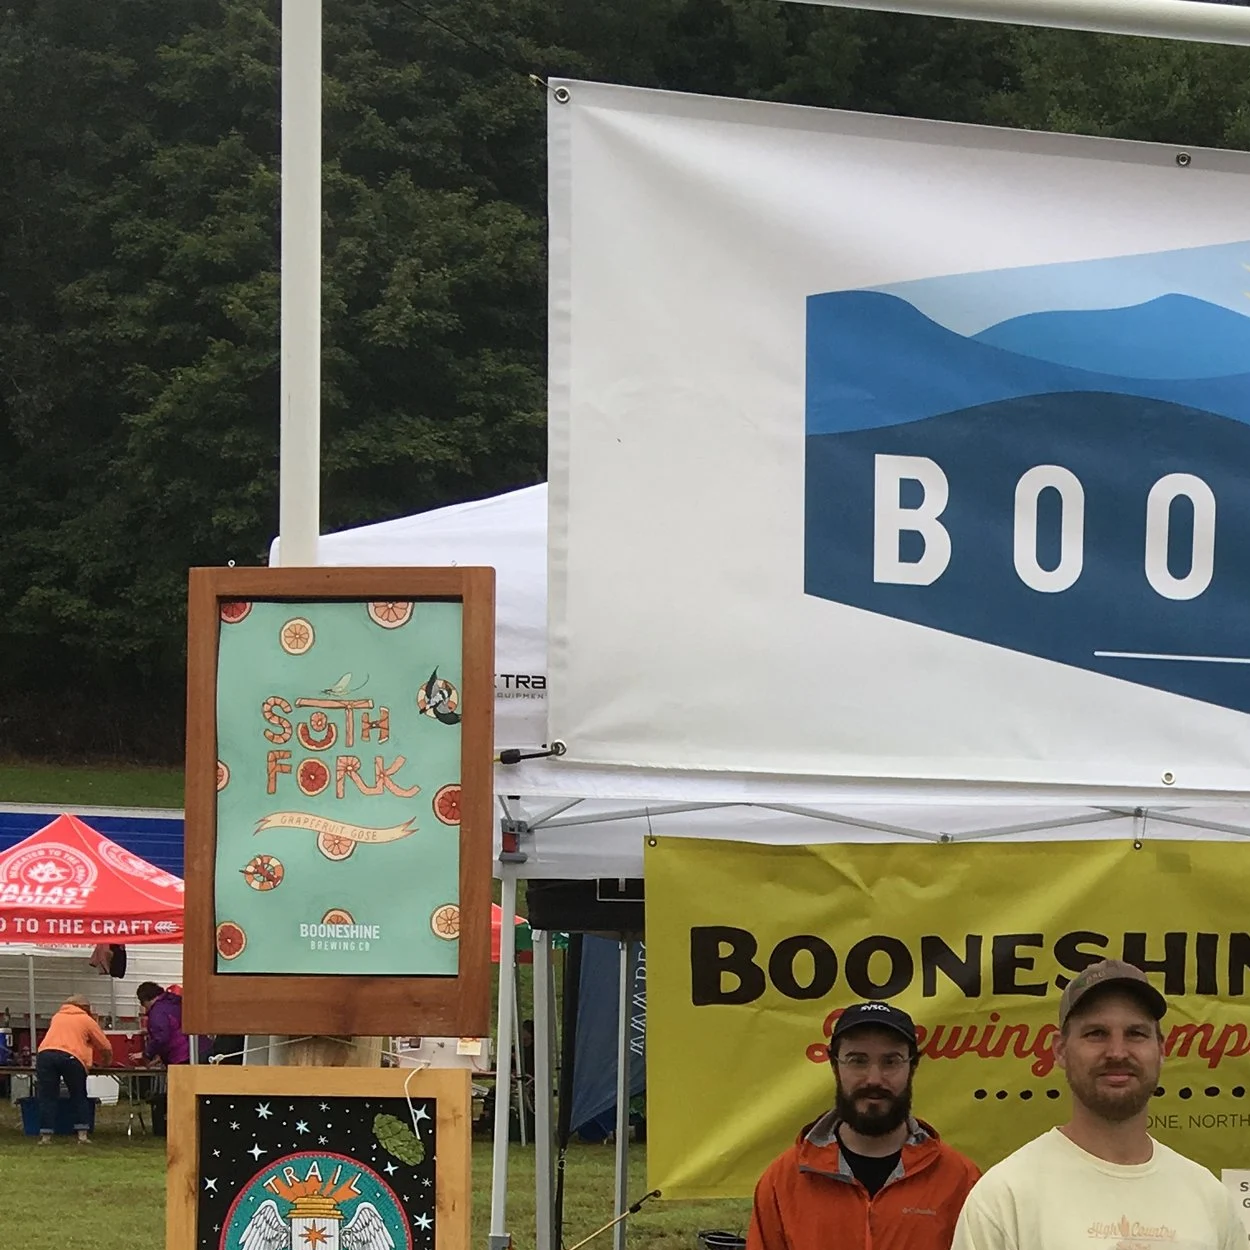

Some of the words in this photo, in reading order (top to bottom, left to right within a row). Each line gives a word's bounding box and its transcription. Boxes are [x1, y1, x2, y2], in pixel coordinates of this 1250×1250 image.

[494, 674, 546, 689] TRA
[267, 750, 420, 798] FORK
[281, 815, 345, 834] GRAPEFRUIT
[351, 829, 378, 841] GOSE
[0, 883, 95, 898] ALLAST
[13, 917, 39, 933] TO
[46, 918, 84, 934] THE
[91, 920, 153, 935] CRAFT
[300, 923, 380, 939] BOONESHINE
[311, 941, 355, 951] BREWING
[806, 1008, 1059, 1077] ewing
[1146, 1114, 1182, 1130] ONE,
[1189, 1113, 1250, 1129] NORTH
[263, 1161, 362, 1196] TRAIL
[1088, 1221, 1117, 1240] High
[1131, 1222, 1177, 1241] Country
